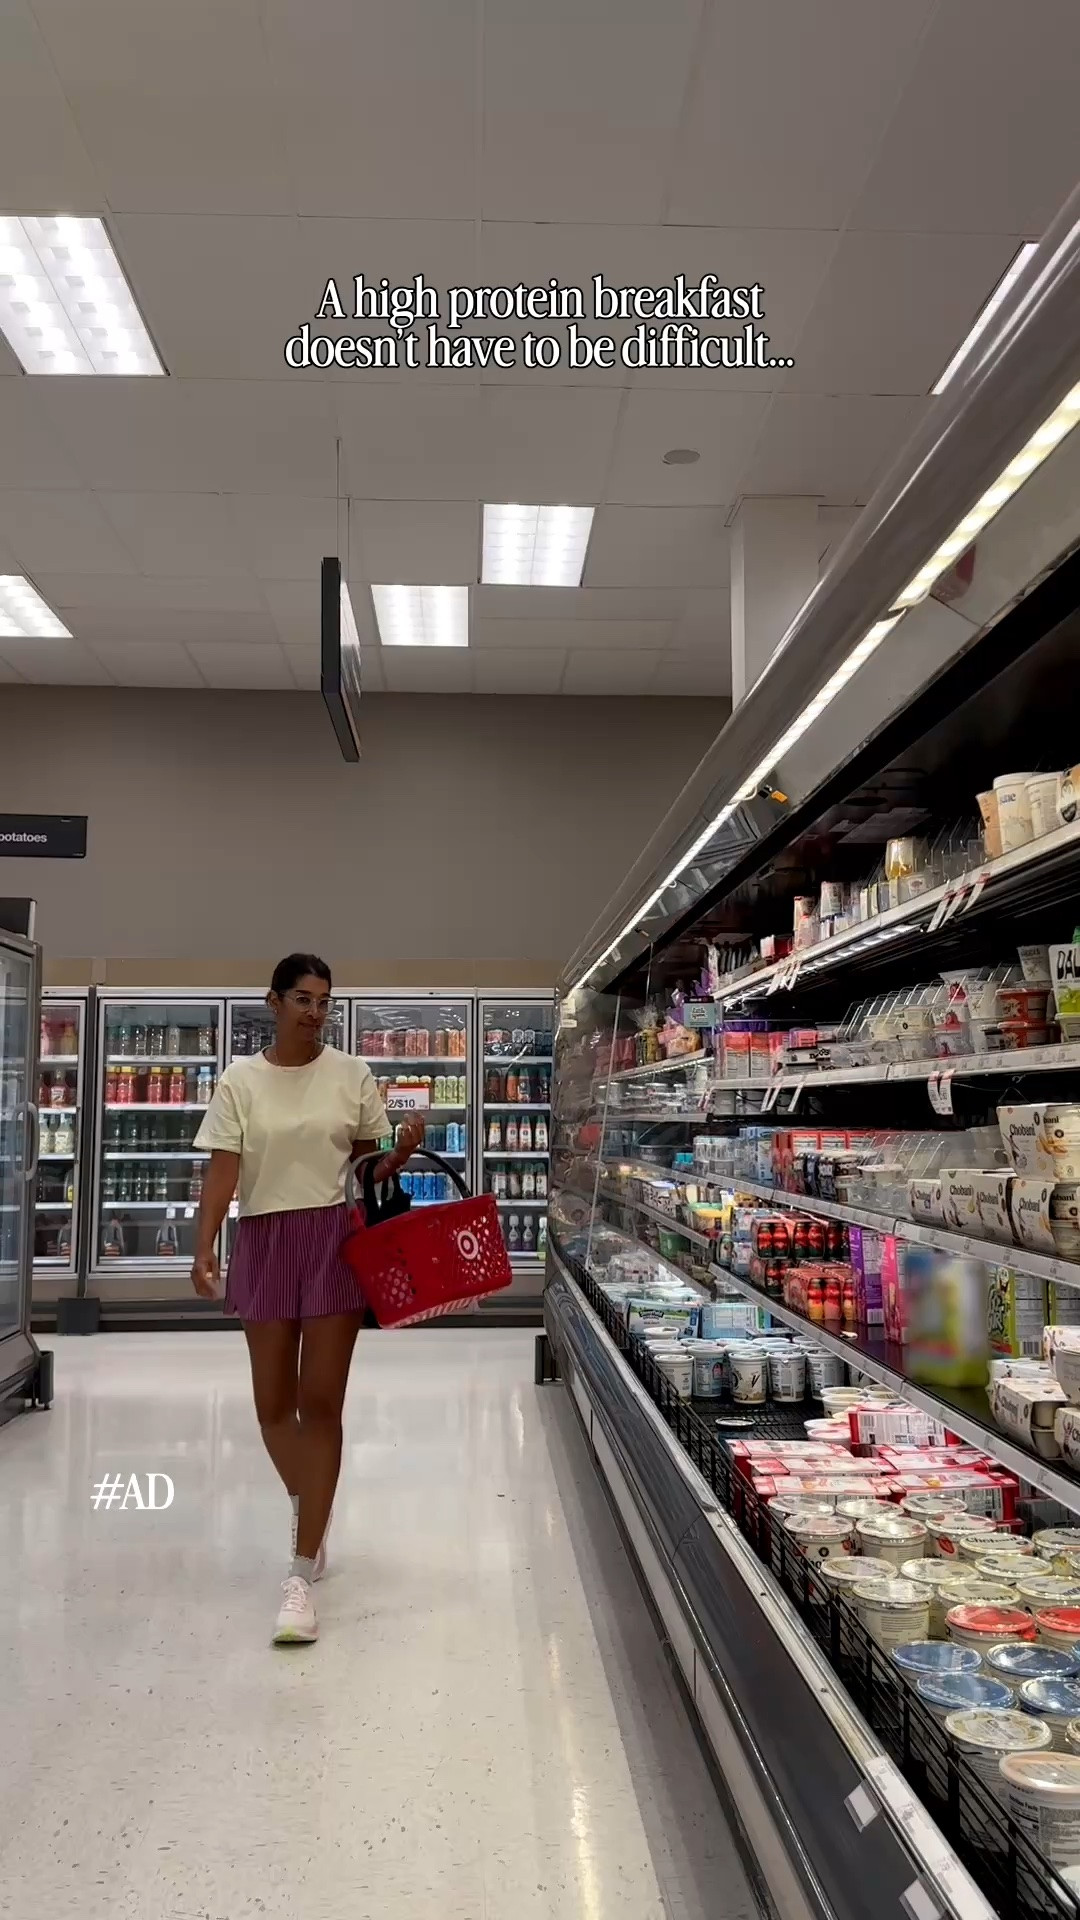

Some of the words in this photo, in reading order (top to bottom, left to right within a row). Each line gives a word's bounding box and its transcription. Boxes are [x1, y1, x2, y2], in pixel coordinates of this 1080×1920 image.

[388, 1099, 415, 1109] 2/$10
[1009, 1123, 1036, 1136] Chobani
[949, 1184, 972, 1196] Chobani
[1019, 1197, 1040, 1212] Chobani
